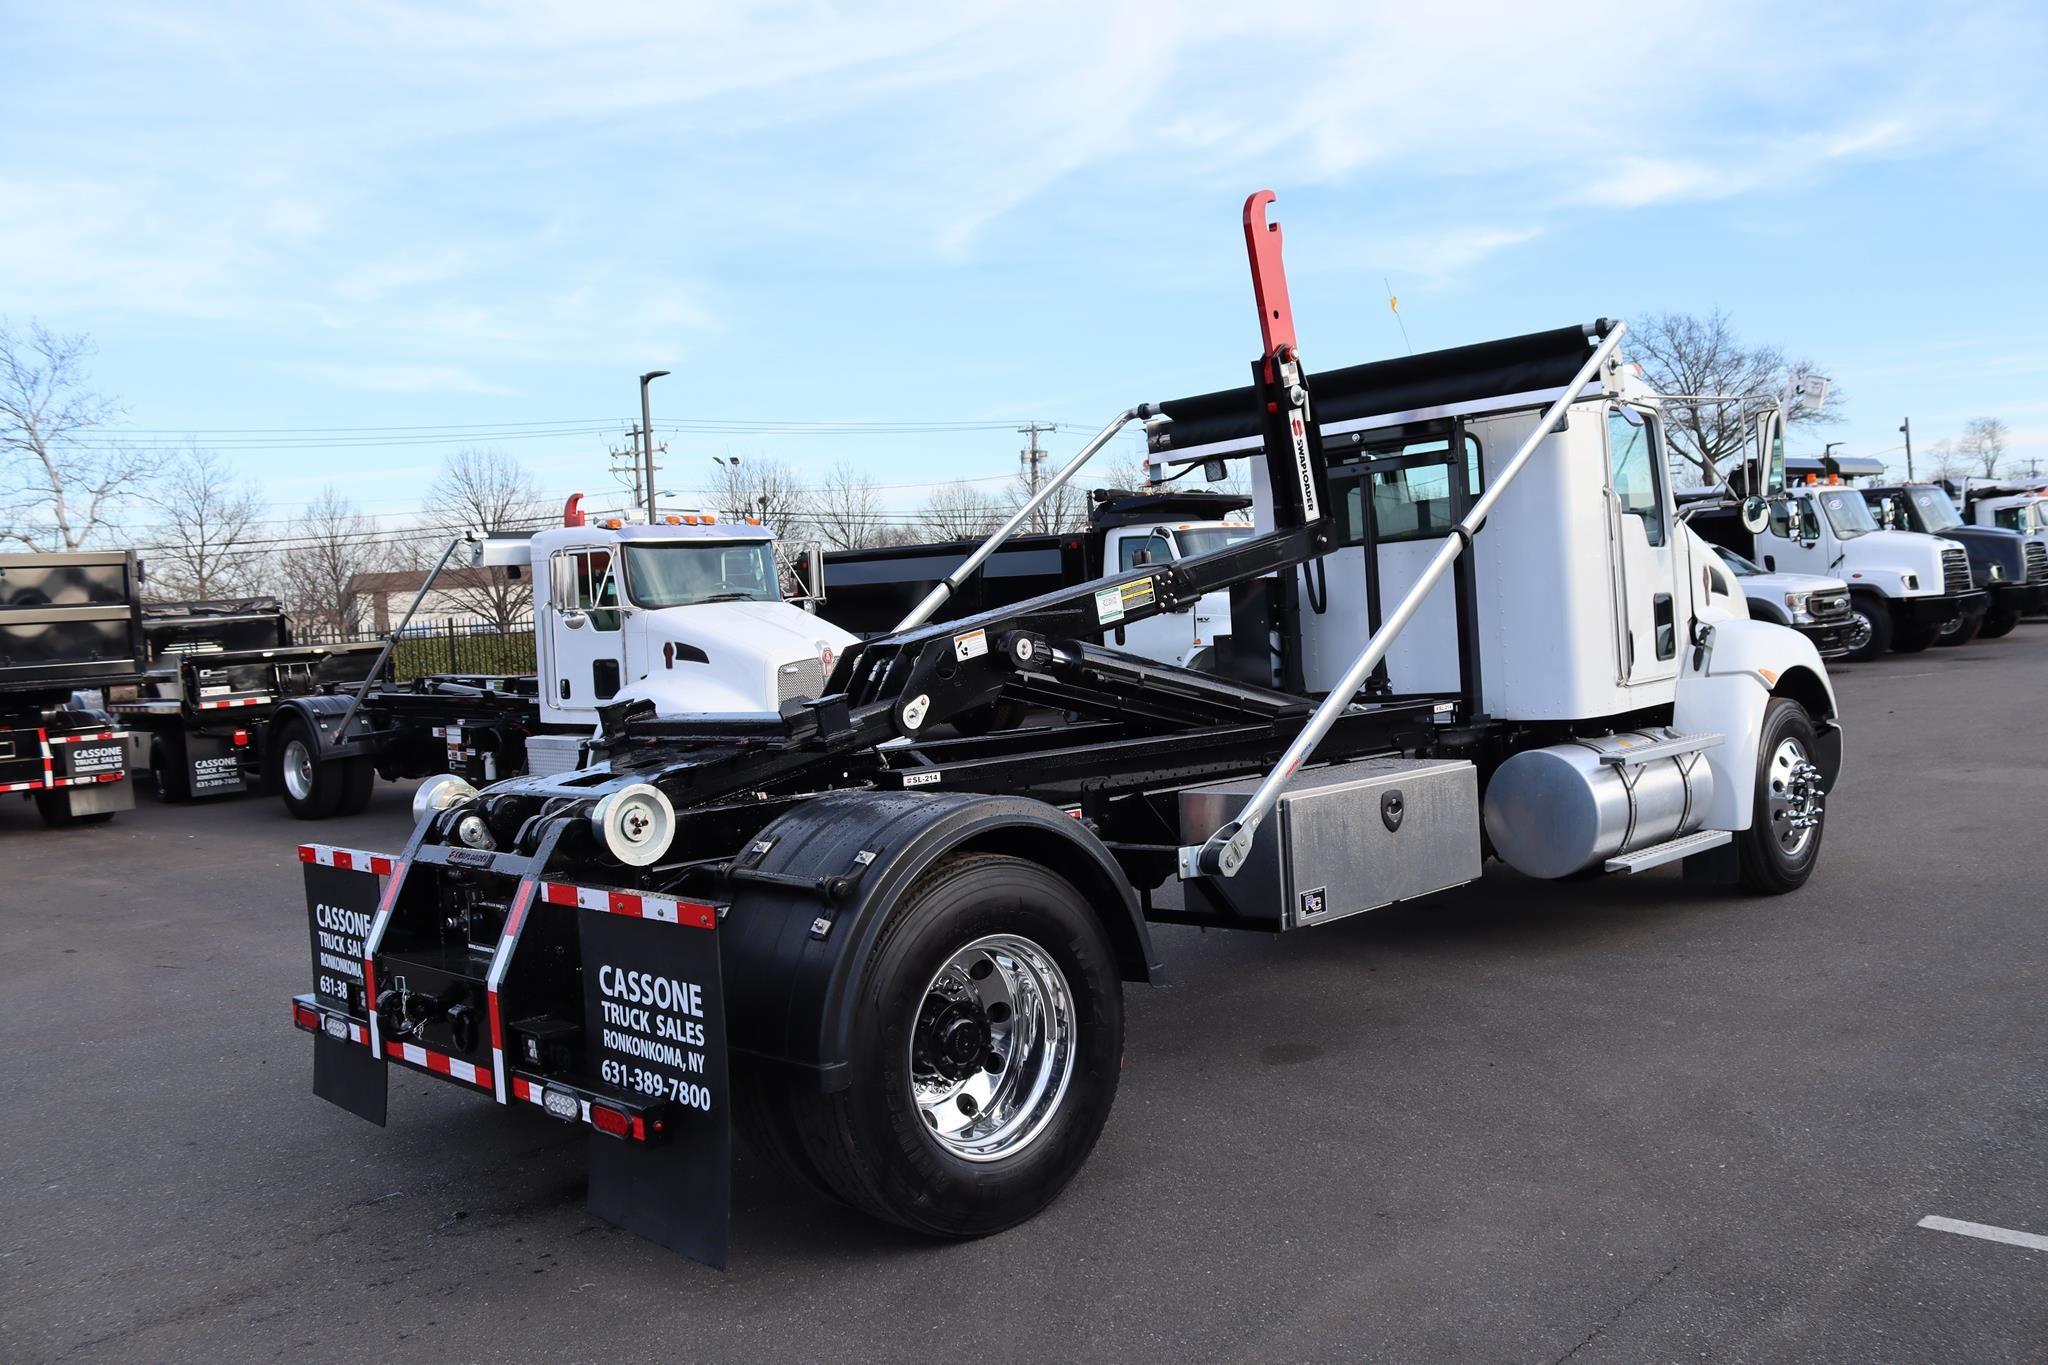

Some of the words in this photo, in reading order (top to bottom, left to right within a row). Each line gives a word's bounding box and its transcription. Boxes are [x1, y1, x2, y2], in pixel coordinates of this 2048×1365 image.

[1296, 440, 1314, 511] SWAPLOADER
[73, 747, 122, 759] CASSONE
[195, 757, 237, 769] CASSONE
[912, 774, 938, 784] SL-214
[316, 904, 370, 938] CASSONE
[318, 931, 345, 953] TRUCK
[599, 965, 704, 1018] CASSONE
[601, 1001, 650, 1034] TRUCK
[656, 1015, 705, 1047] SALES
[603, 1029, 687, 1072] RONKONKOMA,
[688, 1051, 705, 1074] NY
[601, 1060, 711, 1111] 631-389-7800
